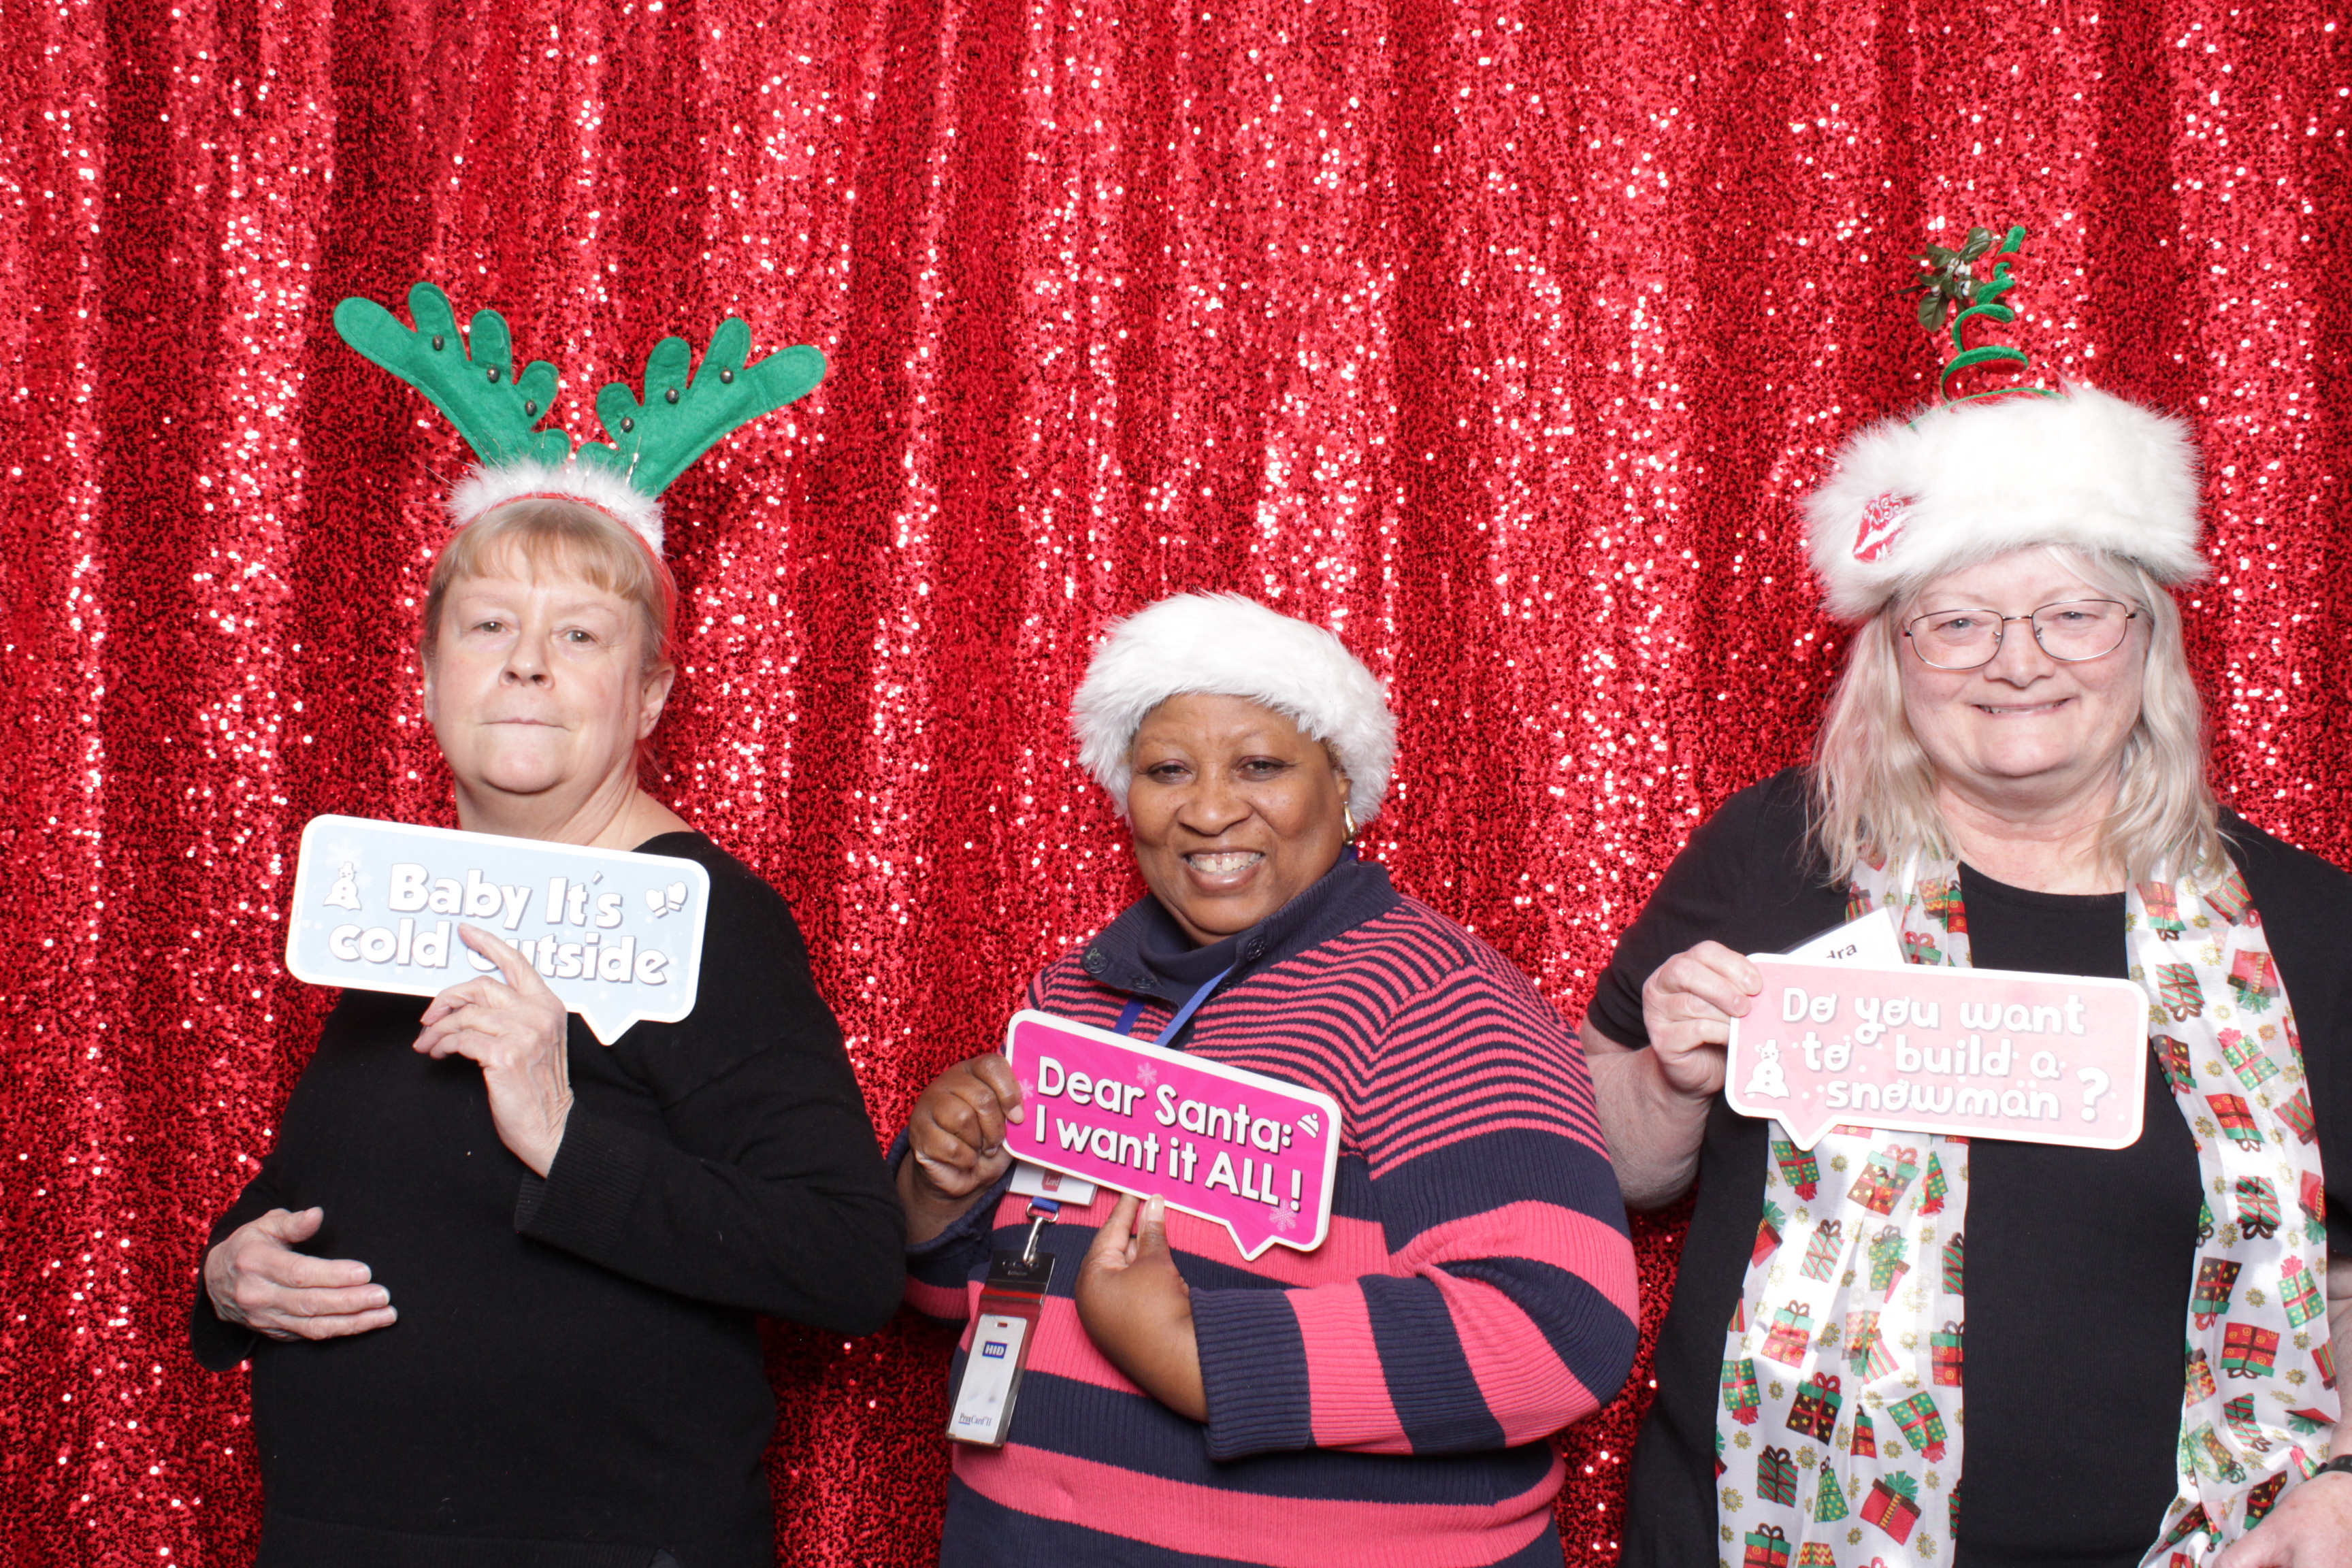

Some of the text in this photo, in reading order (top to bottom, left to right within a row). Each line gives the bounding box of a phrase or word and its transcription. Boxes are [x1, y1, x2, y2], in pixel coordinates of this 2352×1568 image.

[388, 863, 623, 930] Baby It's
[328, 918, 452, 968] cold
[1782, 987, 2087, 1045] Do you want
[1801, 1031, 2060, 1080] to build a
[1036, 1056, 1294, 1155] Dear Santa:
[1825, 1079, 2061, 1120] snowman
[1035, 1104, 1047, 1143] I
[1056, 1117, 1161, 1174] want
[1168, 1137, 1198, 1183] it
[985, 1344, 1005, 1356] HID
